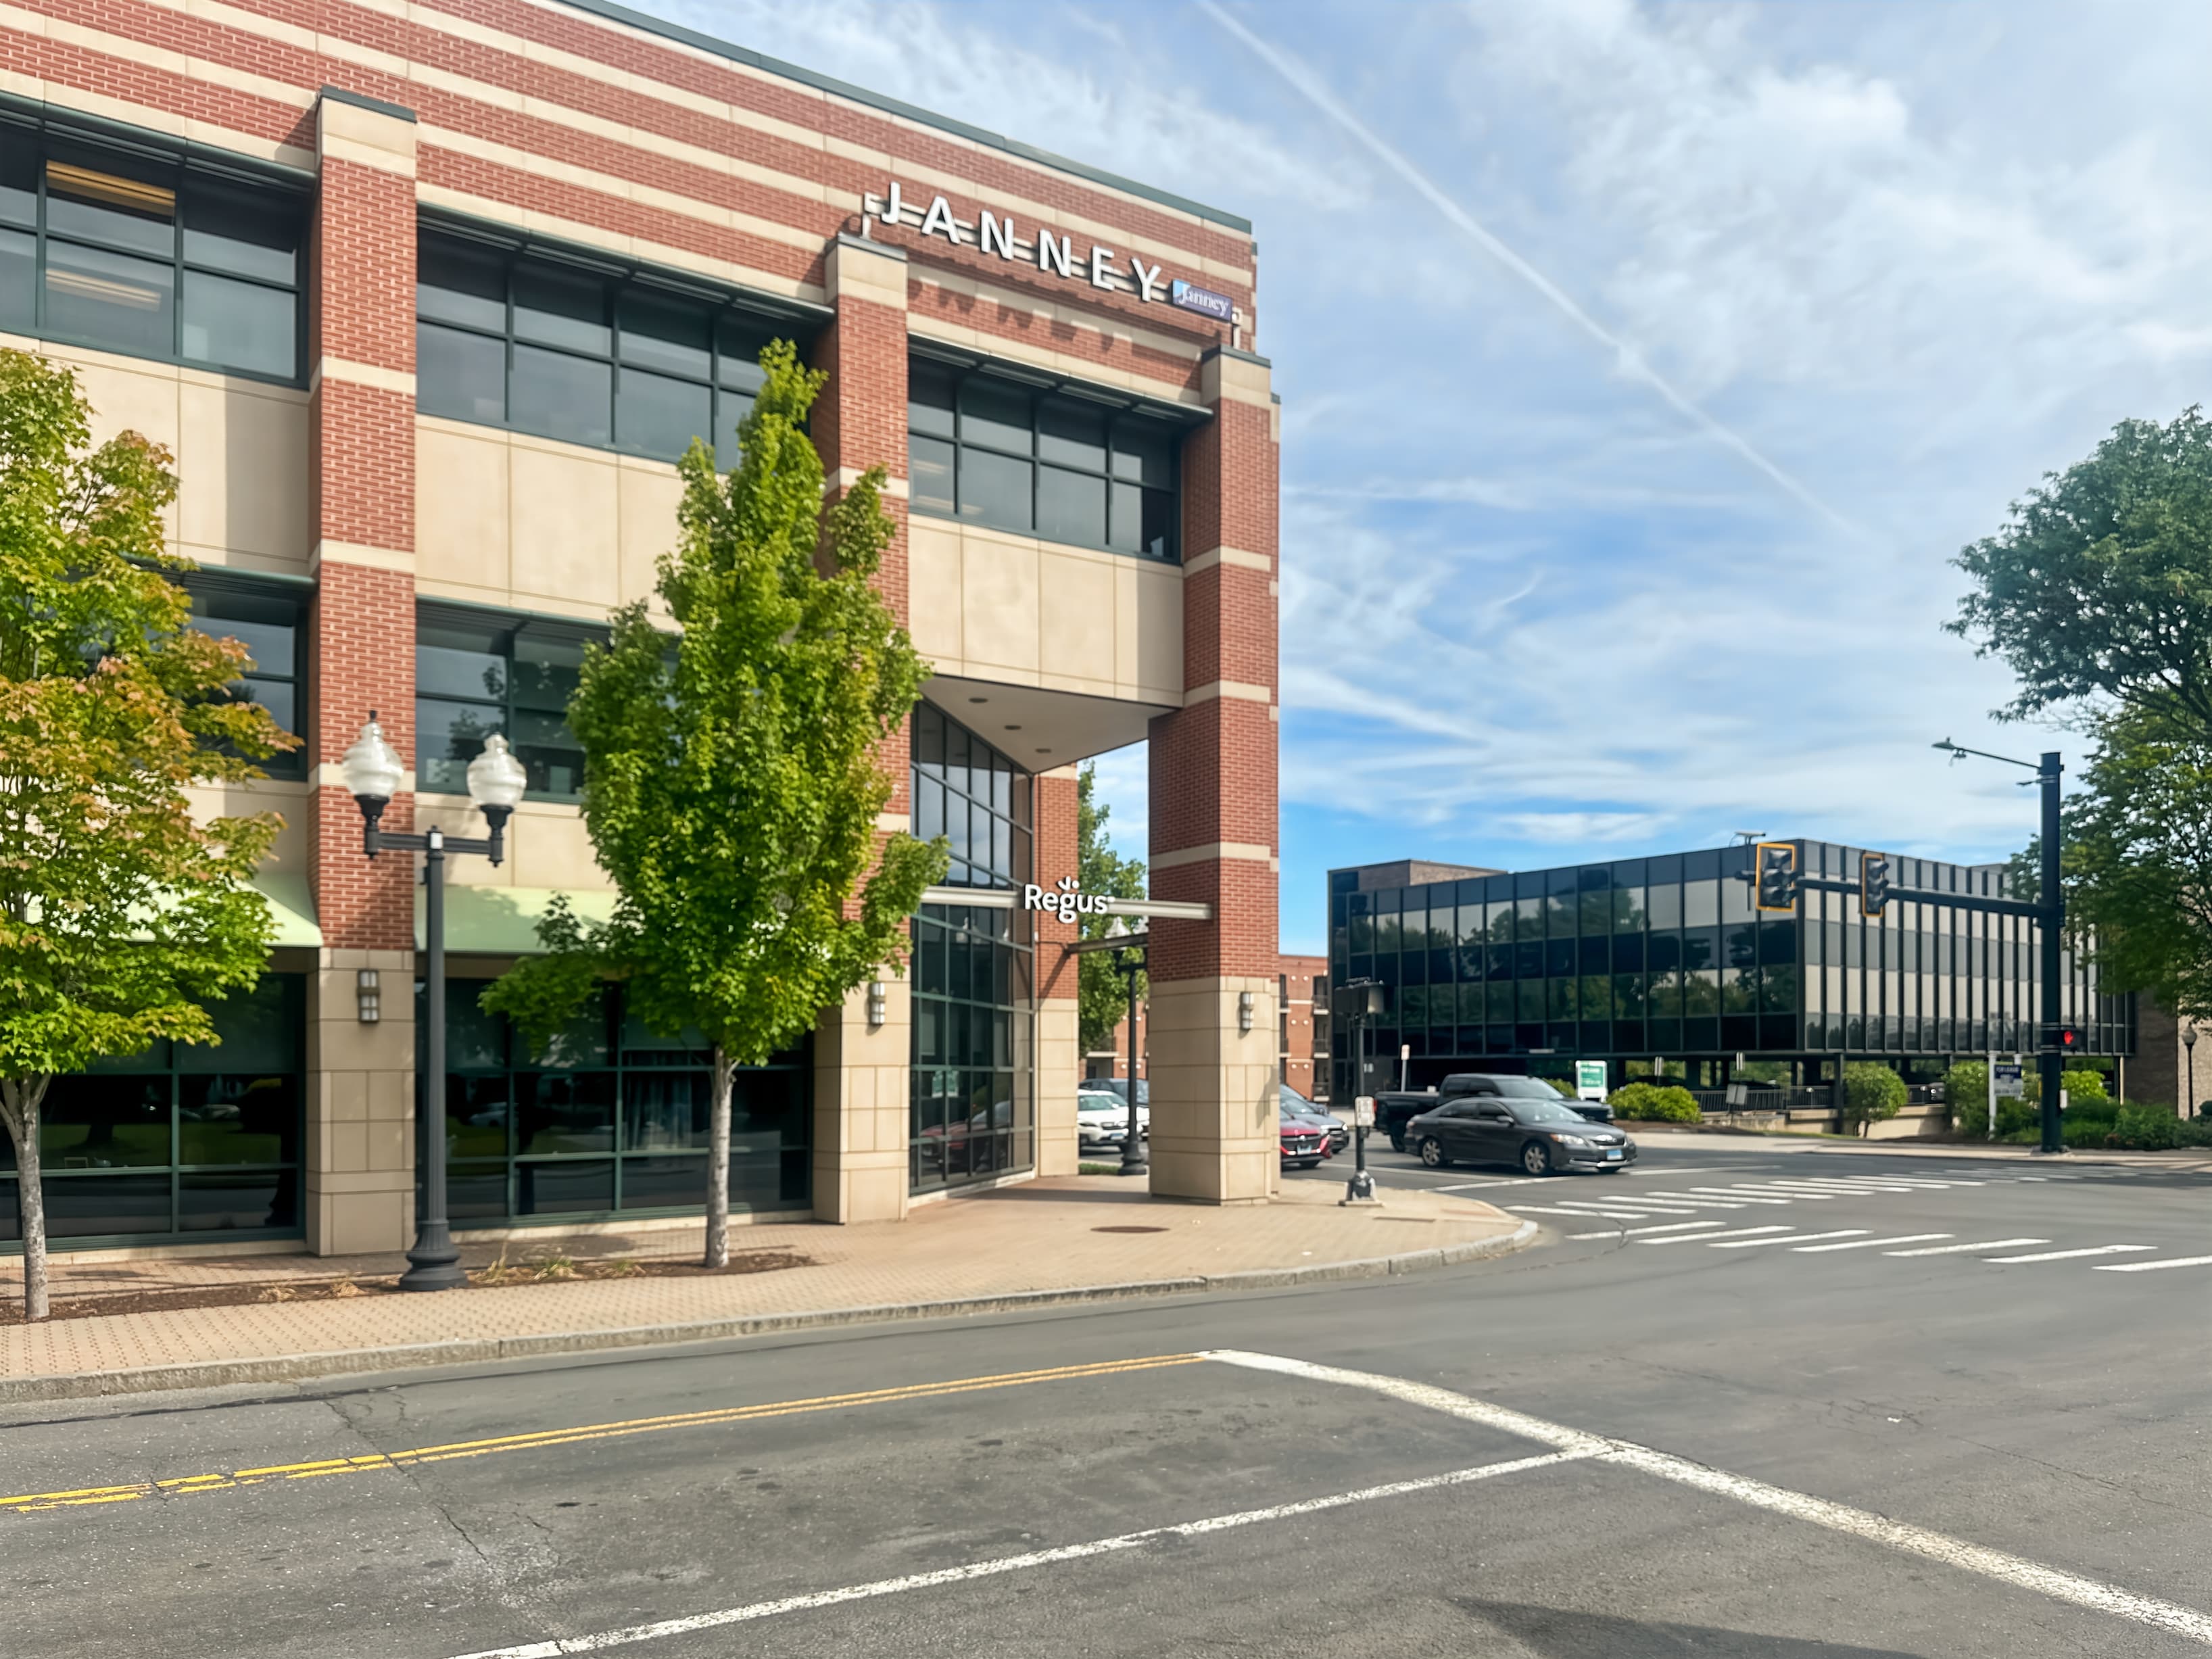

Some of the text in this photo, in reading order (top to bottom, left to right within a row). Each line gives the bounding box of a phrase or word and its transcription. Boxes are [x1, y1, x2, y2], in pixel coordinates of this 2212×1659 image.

[881, 181, 1161, 302] JANNEY
[1178, 285, 1228, 316] Janney
[1024, 882, 1109, 923] Regus
